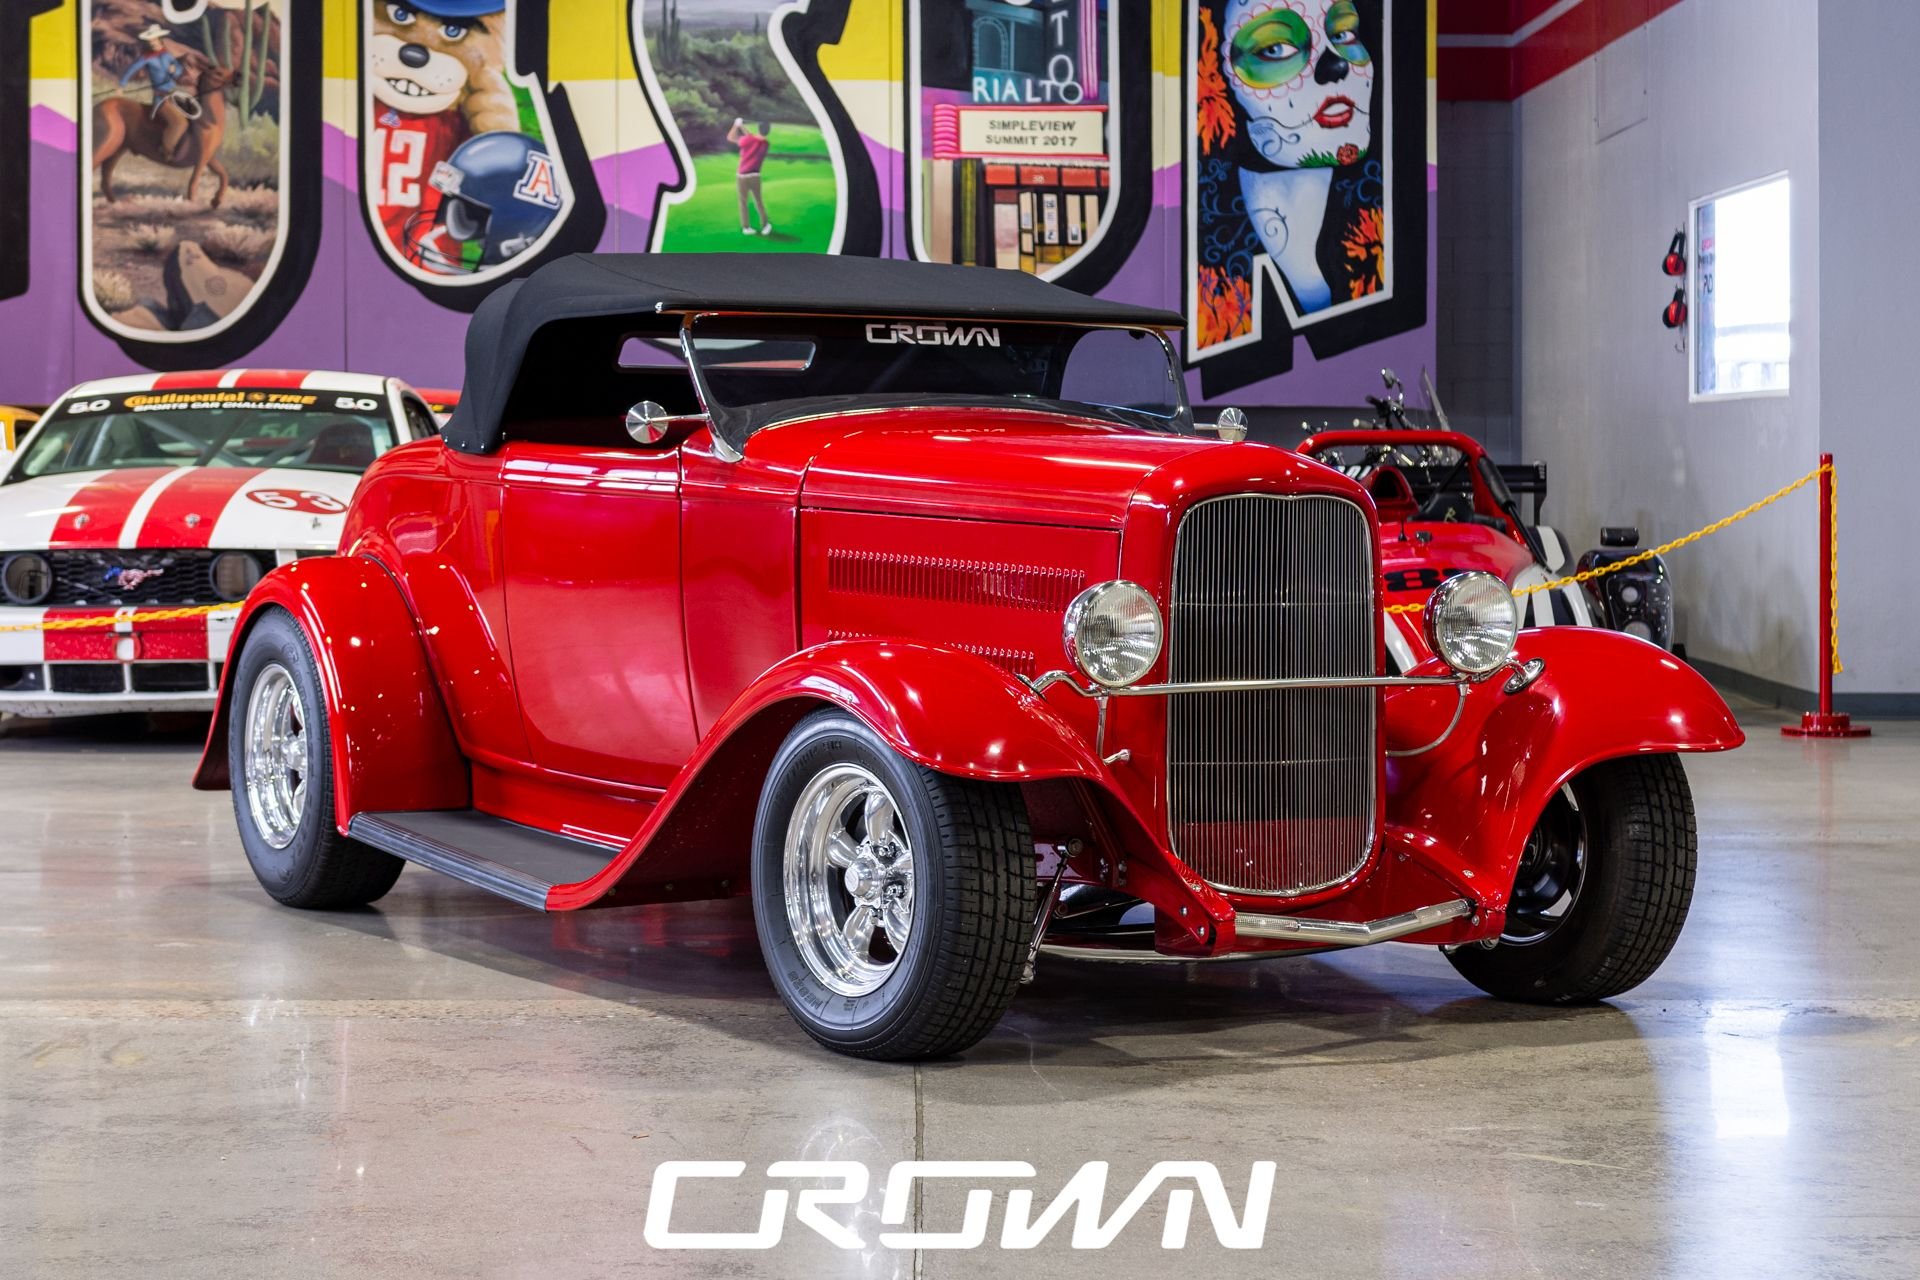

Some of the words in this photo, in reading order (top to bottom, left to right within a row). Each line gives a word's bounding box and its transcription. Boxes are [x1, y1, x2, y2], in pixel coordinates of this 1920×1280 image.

[972, 76, 1083, 104] RIALTO
[988, 120, 1076, 131] SIMPLEVIEW
[985, 134, 1038, 146] SUMMIT
[1042, 135, 1078, 147] 2017
[513, 150, 563, 210] A
[865, 323, 1001, 348] CROWN
[123, 391, 245, 408] Continental
[267, 393, 317, 405] TIRE
[133, 402, 188, 412] SPORTS
[190, 401, 220, 410] CAR
[222, 401, 303, 411] CHALLENGE
[252, 490, 347, 512] 53
